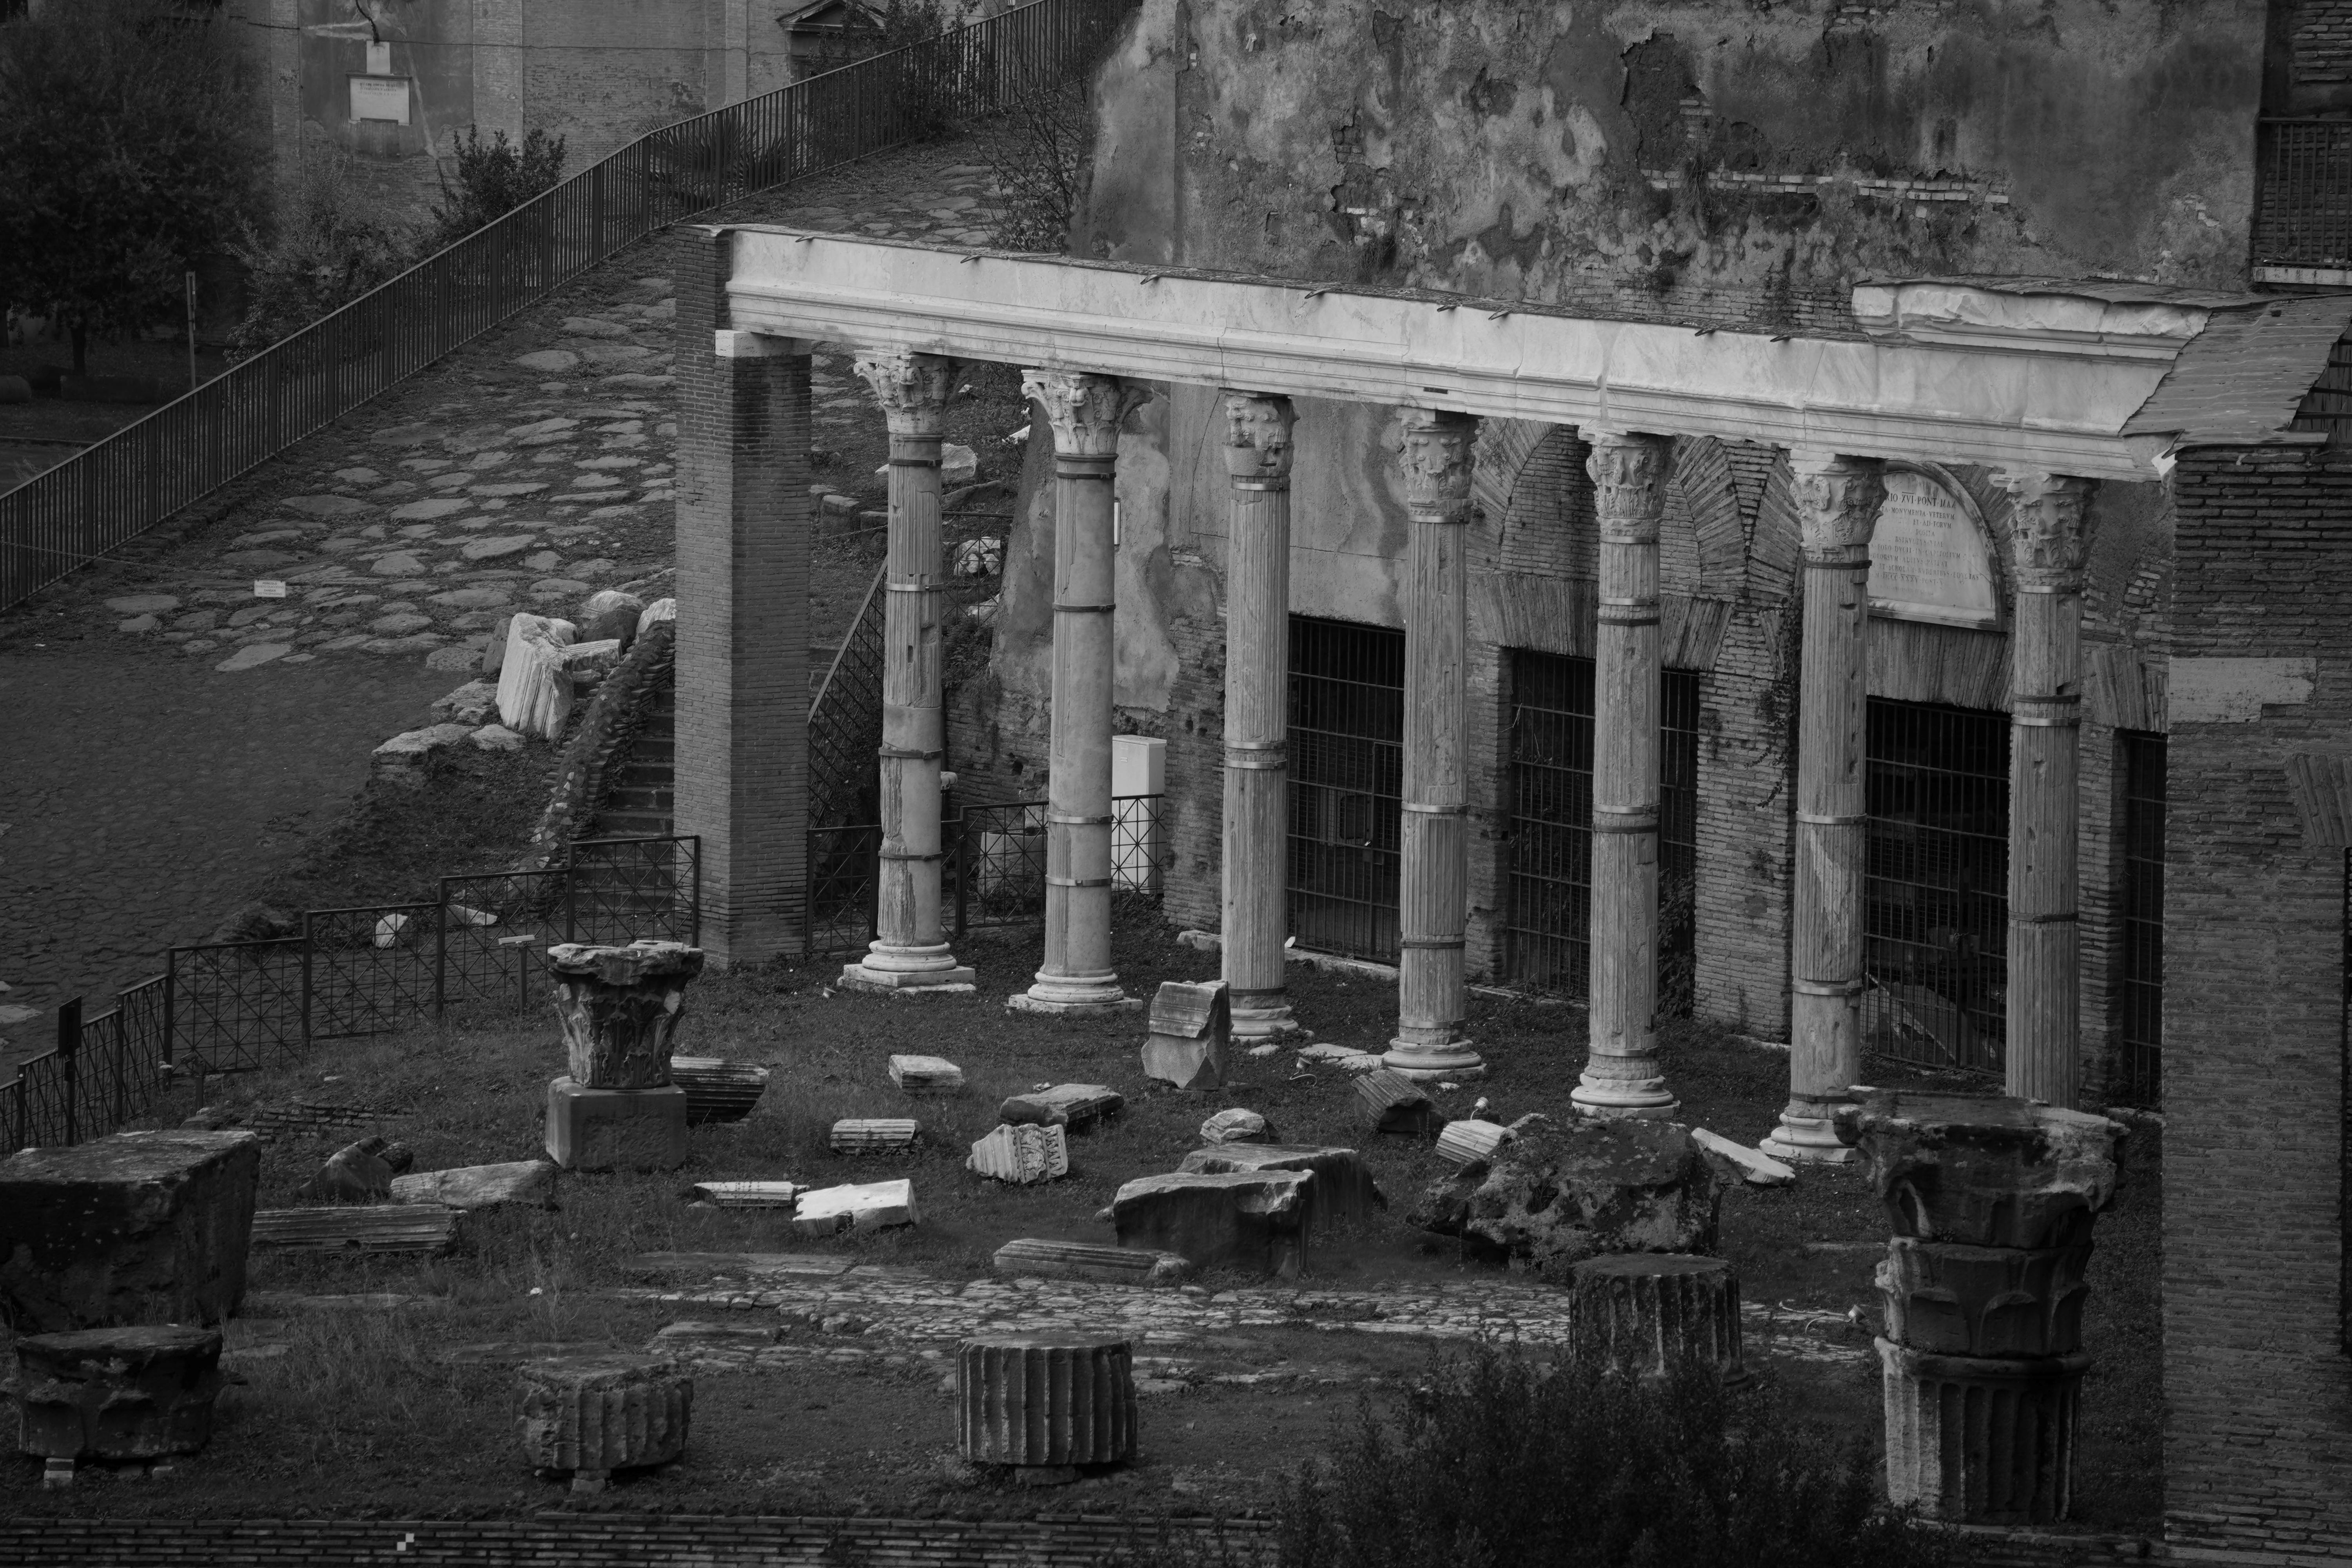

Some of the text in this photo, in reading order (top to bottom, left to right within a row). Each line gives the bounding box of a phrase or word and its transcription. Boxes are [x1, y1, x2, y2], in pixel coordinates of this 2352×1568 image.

[1902, 492, 1914, 504] XVI
[1917, 496, 1937, 507] PONT
[1891, 507, 1926, 517] MONVMENTA
[1929, 511, 1955, 520] VETERVM
